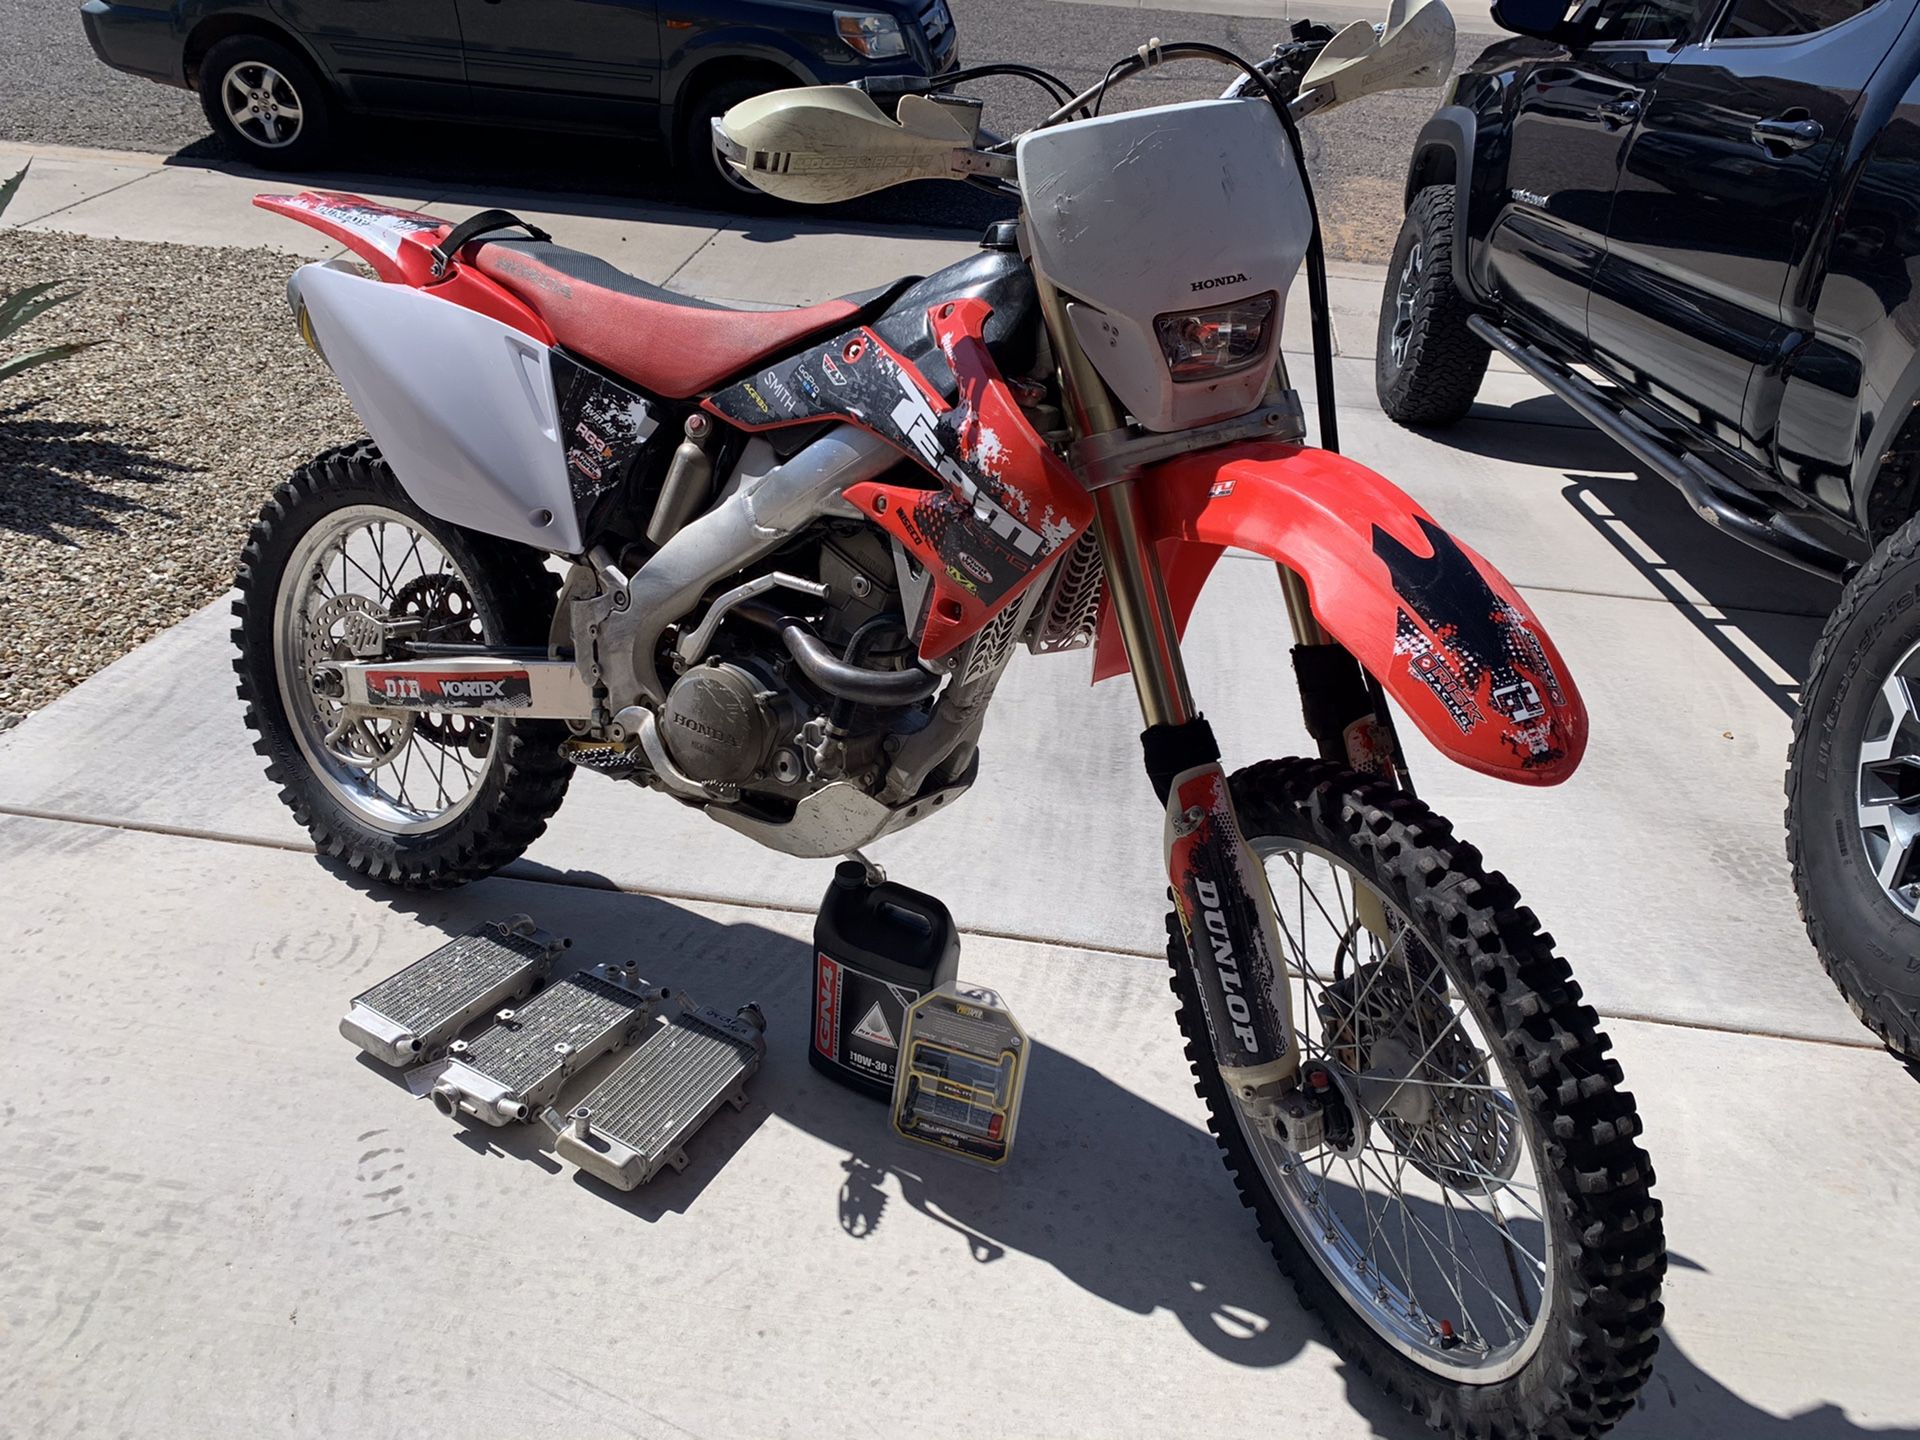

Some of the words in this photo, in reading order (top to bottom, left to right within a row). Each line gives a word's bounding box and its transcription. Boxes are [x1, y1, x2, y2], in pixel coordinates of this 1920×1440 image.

[1190, 273, 1248, 292] HONDA
[764, 371, 796, 412] SMITH
[798, 364, 820, 394] GoPro
[582, 401, 605, 425] Twin
[601, 421, 618, 436] Air
[575, 422, 606, 453] RG3
[896, 506, 923, 545] WISECO
[438, 680, 506, 697] VORTEX
[1425, 673, 1470, 725] RACING
[1194, 876, 1259, 1053] DUNLOP
[820, 966, 834, 1050] GN4
